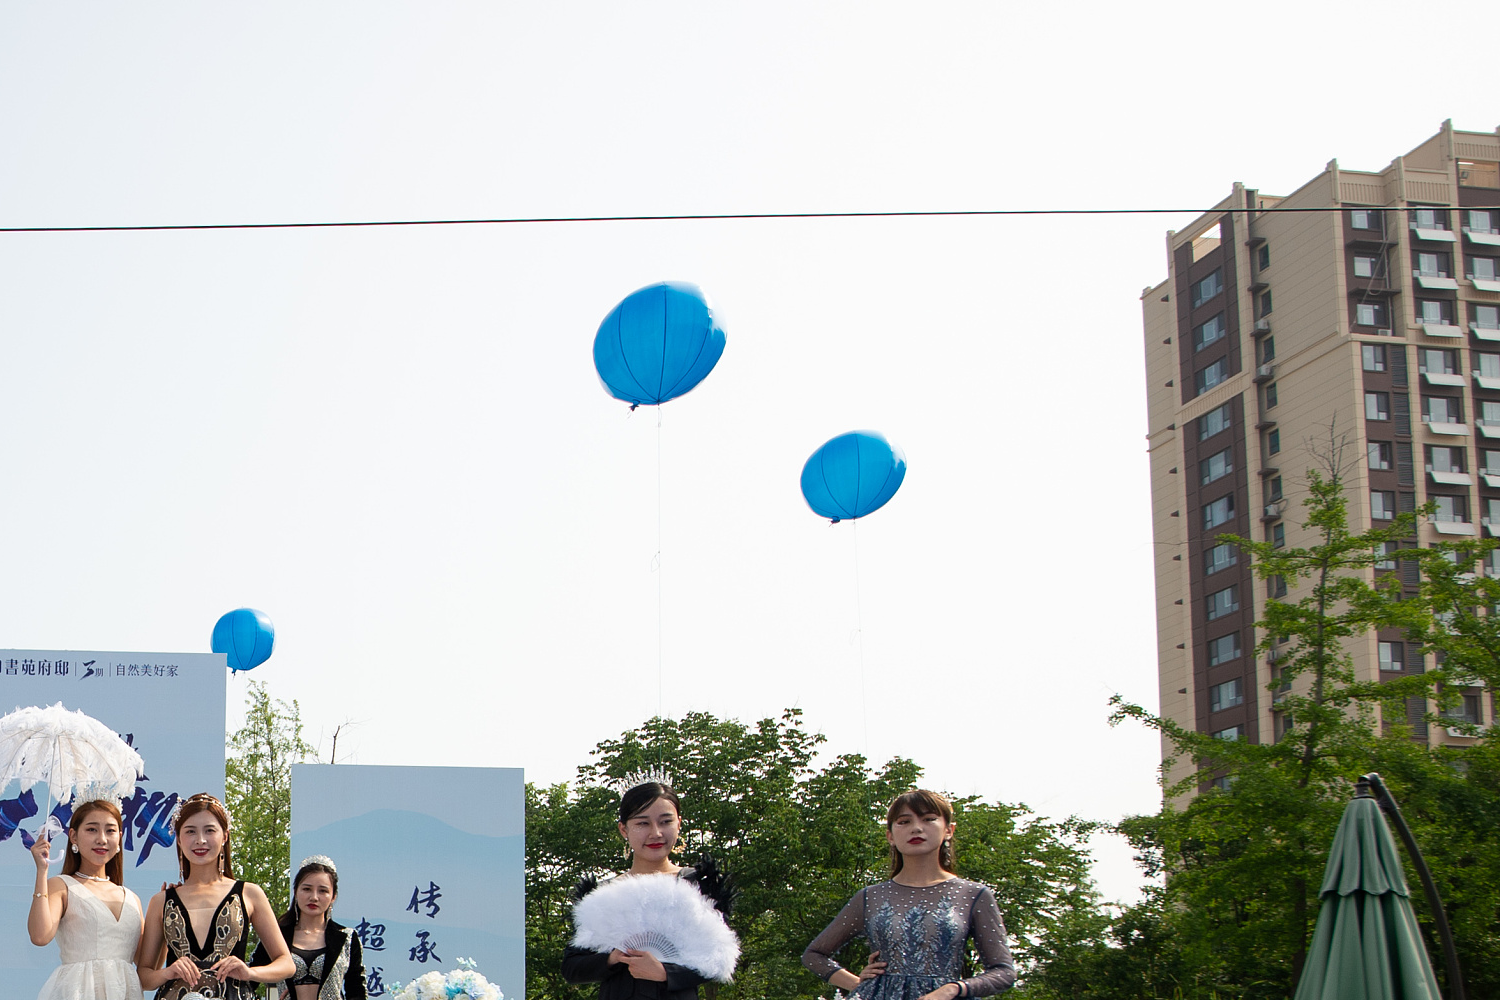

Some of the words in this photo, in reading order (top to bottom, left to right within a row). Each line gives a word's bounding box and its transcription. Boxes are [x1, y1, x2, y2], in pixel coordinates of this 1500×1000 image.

[116, 663, 179, 677] 自然美好家
